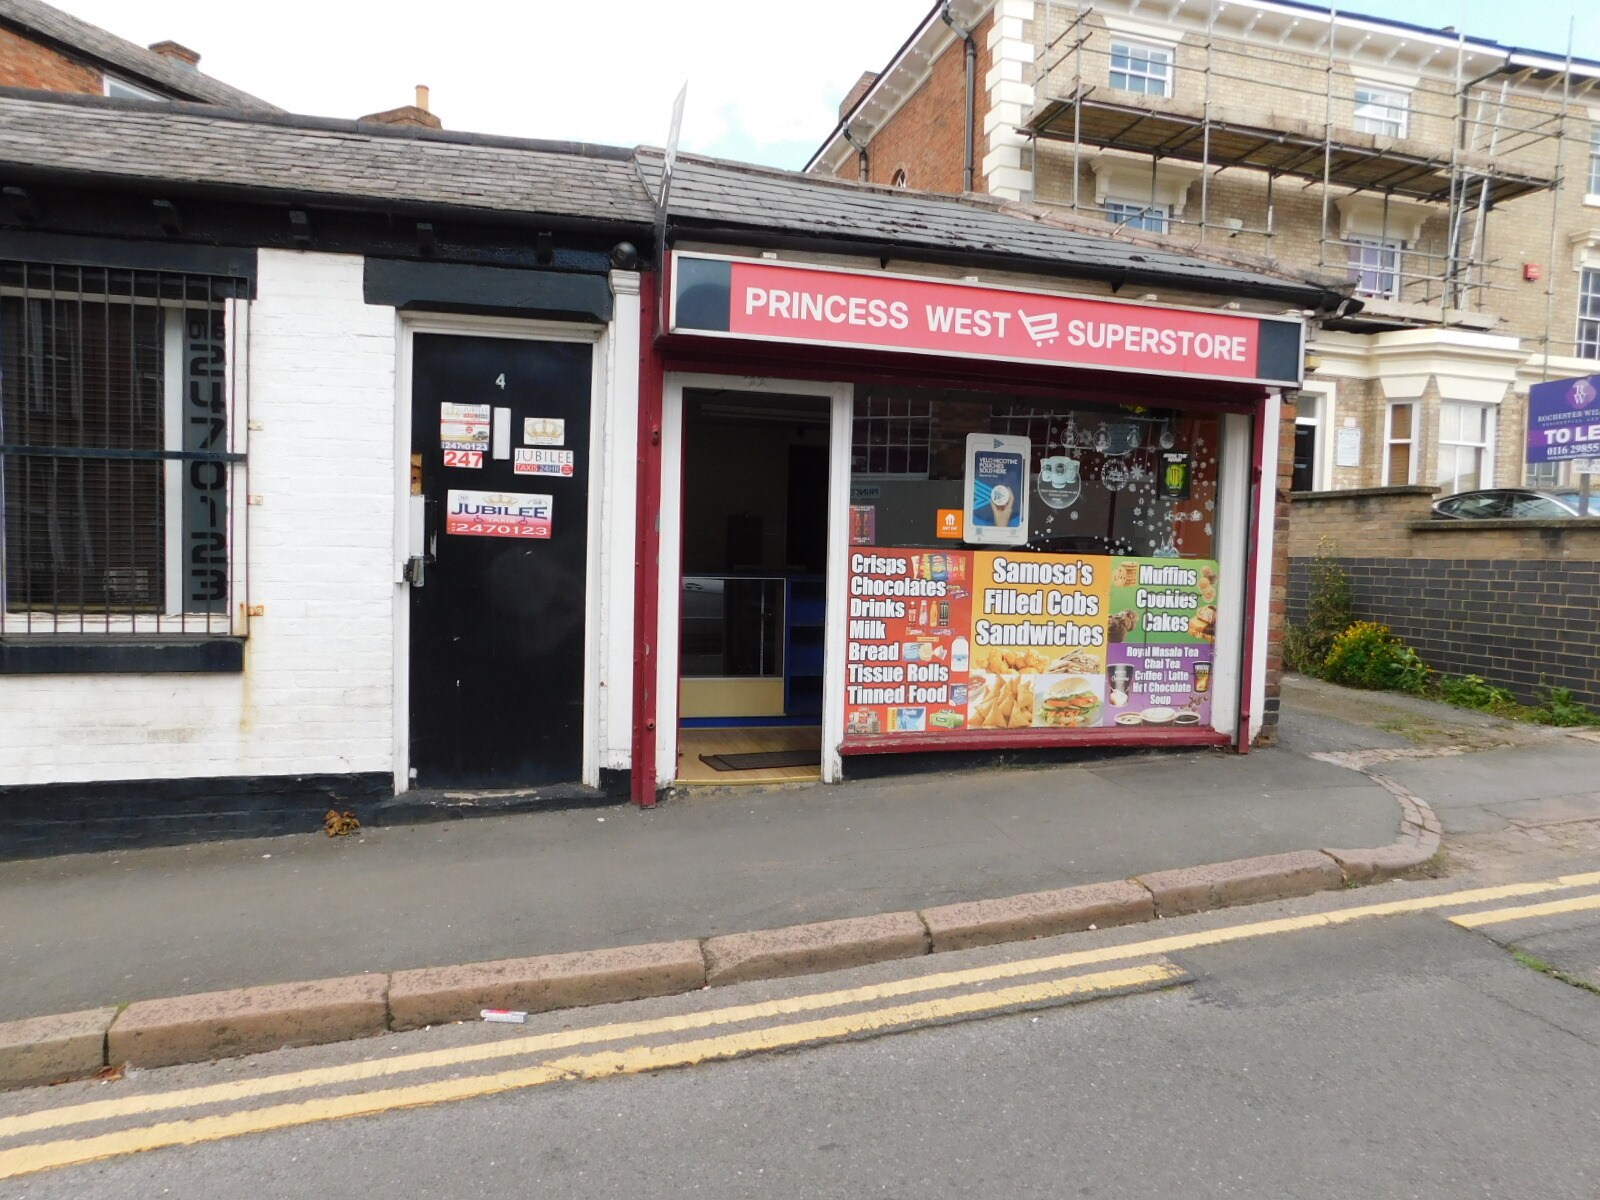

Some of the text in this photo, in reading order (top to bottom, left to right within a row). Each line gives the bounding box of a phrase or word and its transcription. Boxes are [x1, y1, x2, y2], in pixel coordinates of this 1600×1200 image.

[745, 286, 1247, 362] PRINCESS WEST SUPERSTORE
[495, 373, 506, 390] 4
[1538, 410, 1582, 422] ROCHESTER
[1544, 428, 1570, 444] TO
[445, 451, 483, 467] 247
[515, 450, 573, 464] JUBILEE
[1547, 445, 1568, 456] 0116
[516, 463, 538, 472] TAXIS
[539, 464, 560, 473] 24HR
[451, 502, 548, 520] JUBILEE
[455, 523, 548, 536] 2470123
[851, 553, 907, 575] Crisps
[992, 557, 1094, 586] Samosa's
[1139, 565, 1197, 586] Muffins
[850, 576, 948, 597] Chocolates
[850, 598, 905, 618] Drinks
[983, 588, 1100, 616] Filled Cobs
[1136, 589, 1198, 609] Cookies
[849, 620, 886, 640] Milk
[1142, 612, 1189, 633] Cakes
[975, 619, 1104, 646] Sandwiches
[849, 642, 899, 661] Bread
[1126, 646, 1199, 658] Royal Masala Tea
[848, 663, 949, 683] Tissue Rolls
[1144, 659, 1181, 669] Chai Tea
[1134, 671, 1162, 681] Coffee
[1168, 671, 1189, 681] Latte
[847, 685, 905, 704] Tinned
[908, 685, 948, 703] Food
[1148, 682, 1192, 693] Chocolate
[1149, 694, 1171, 705] Soup
